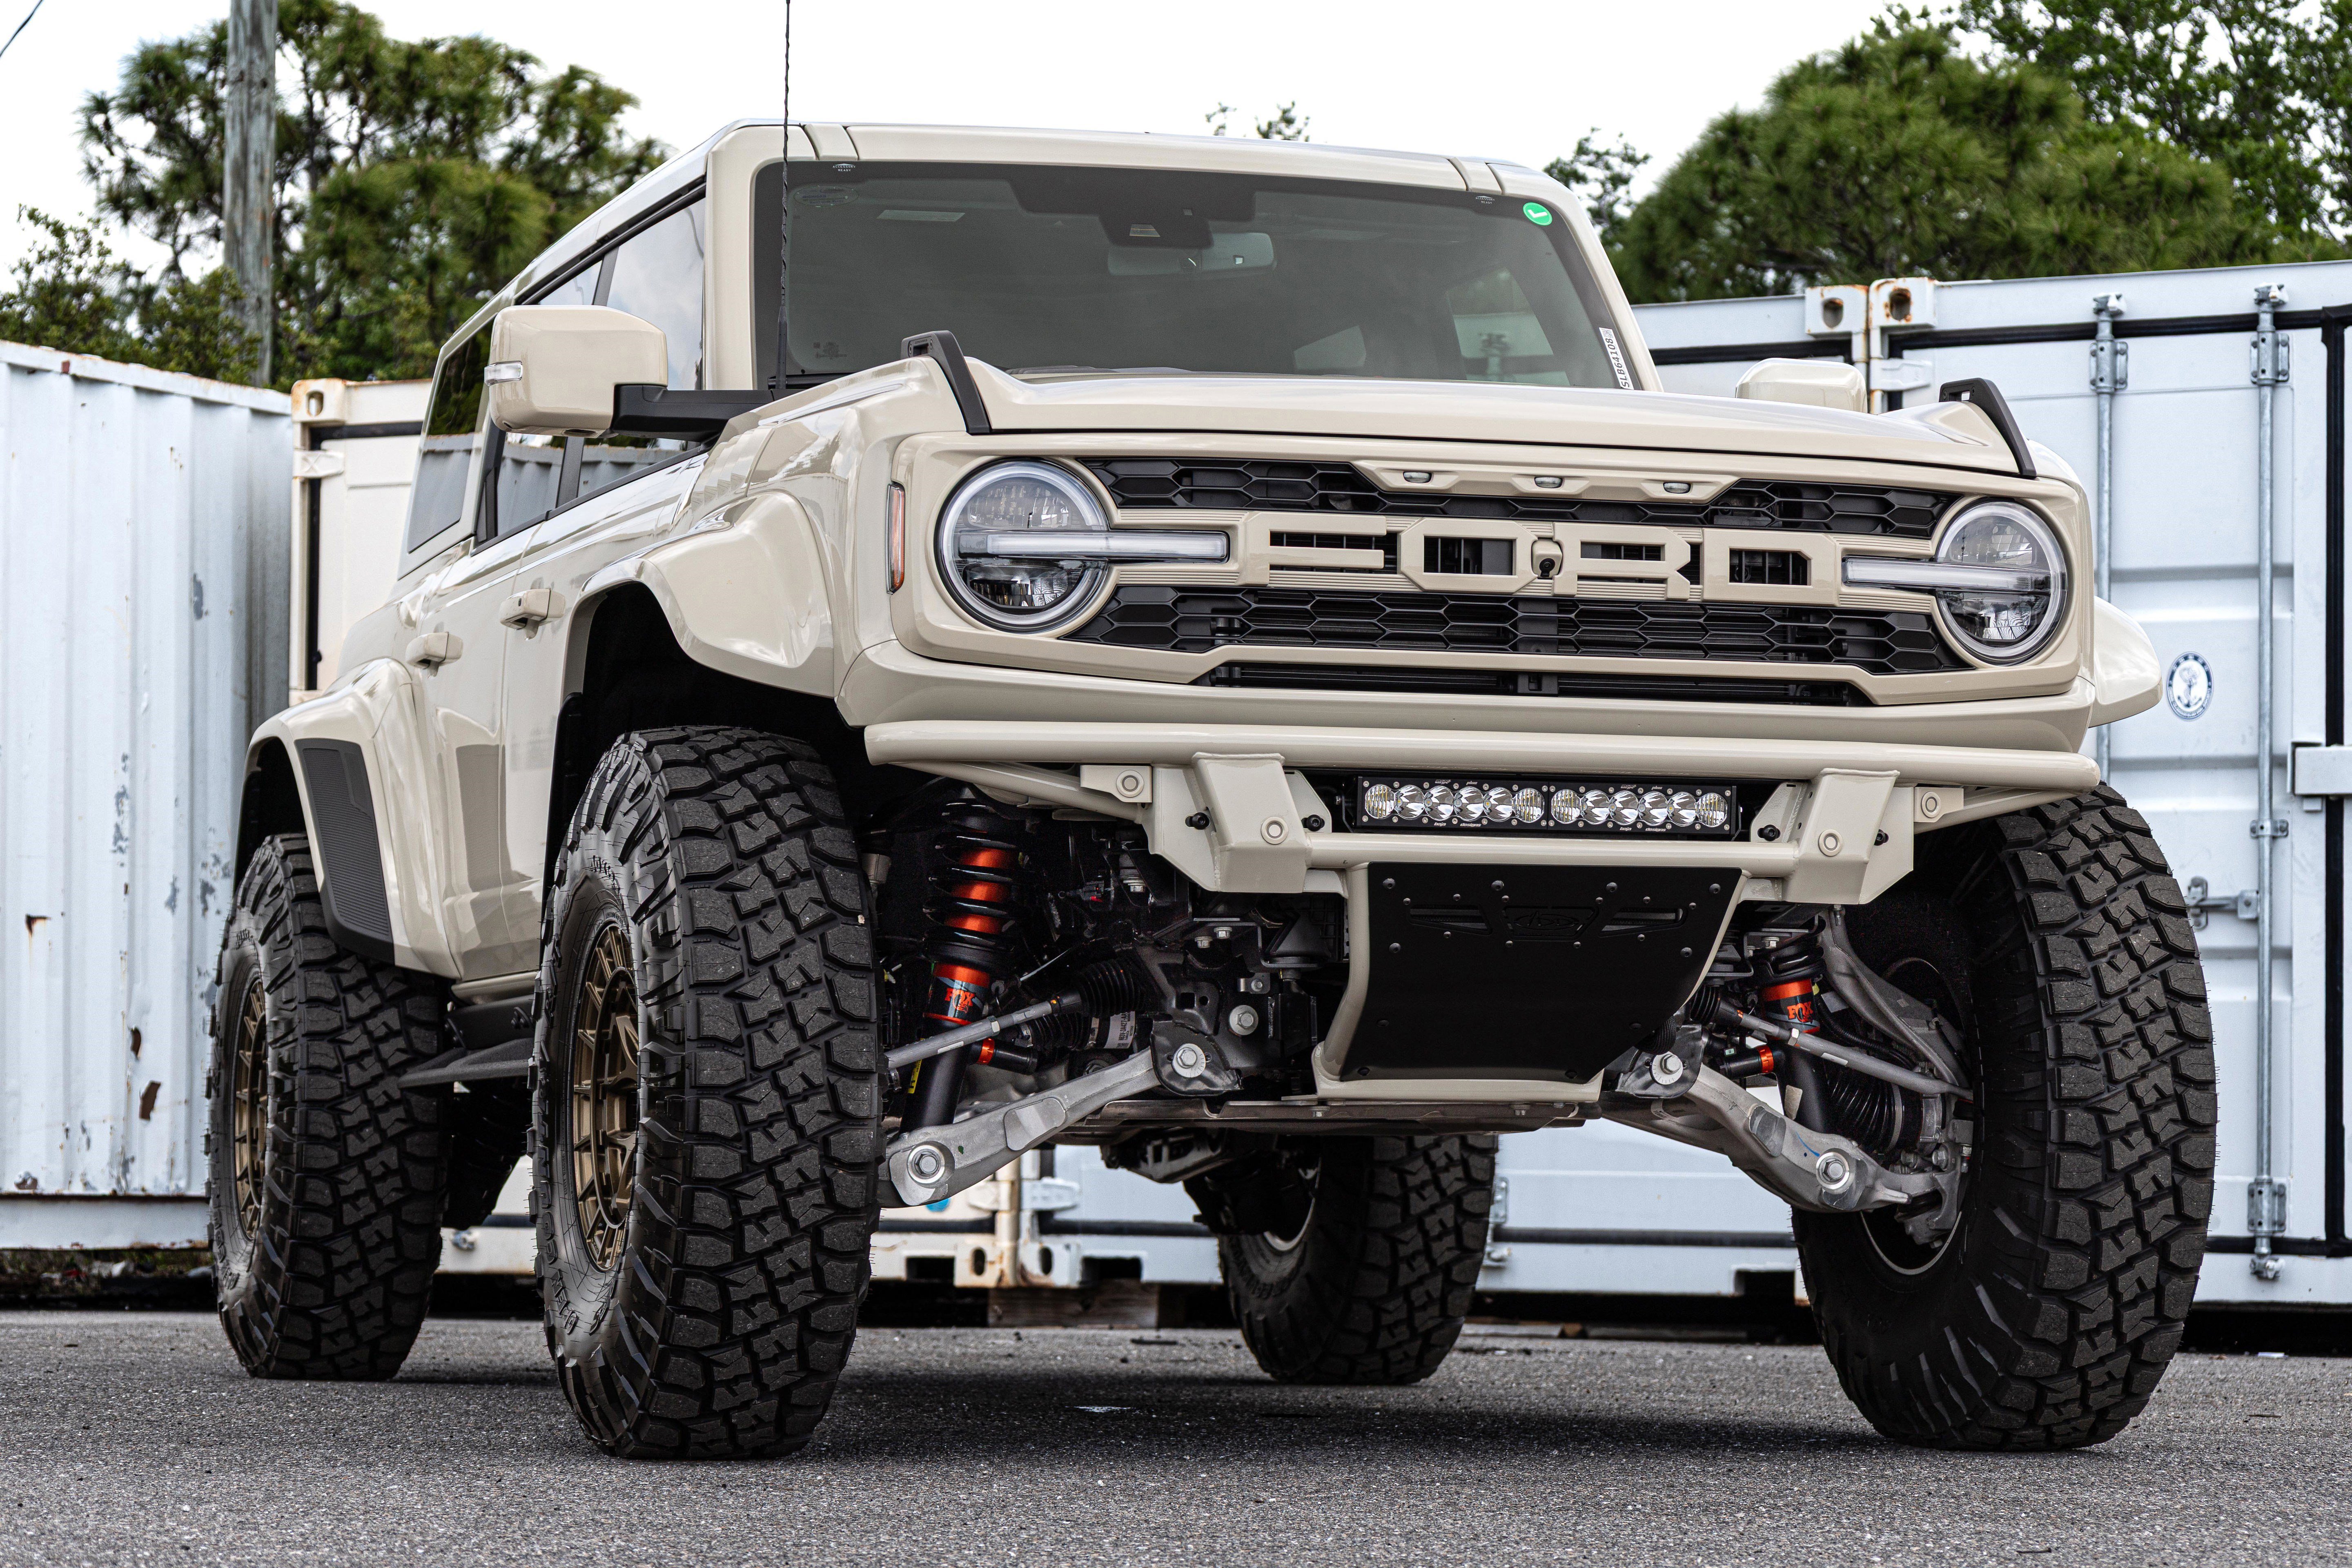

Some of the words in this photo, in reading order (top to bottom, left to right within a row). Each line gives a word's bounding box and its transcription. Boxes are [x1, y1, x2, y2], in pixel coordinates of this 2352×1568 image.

[1605, 338, 1629, 388] SLB64108
[1242, 511, 1839, 606] FORD
[944, 987, 975, 1013] FOX
[1787, 1001, 1813, 1023] FOX
[551, 1268, 579, 1336] OPEN
